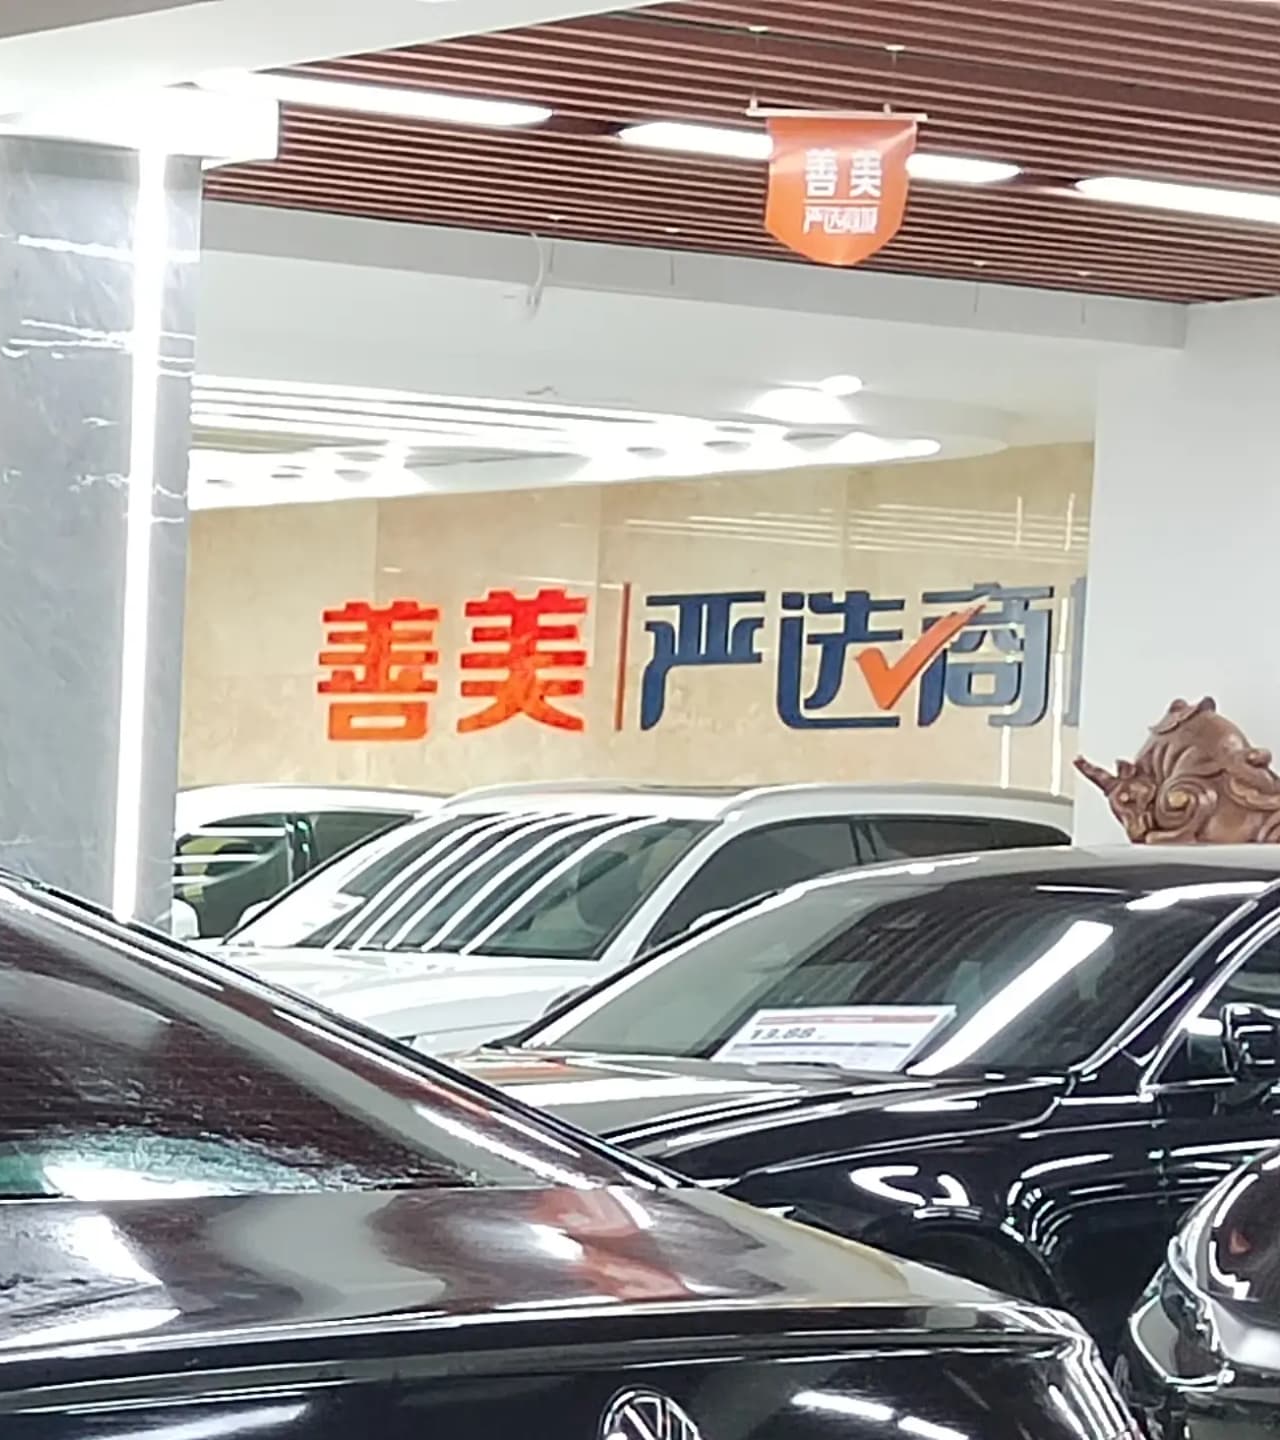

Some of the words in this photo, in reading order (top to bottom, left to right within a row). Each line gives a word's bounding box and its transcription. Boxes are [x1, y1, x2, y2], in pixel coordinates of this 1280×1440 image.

[803, 147, 883, 197] 善美
[317, 587, 589, 741] 善美
[640, 581, 1086, 730] 严选商
